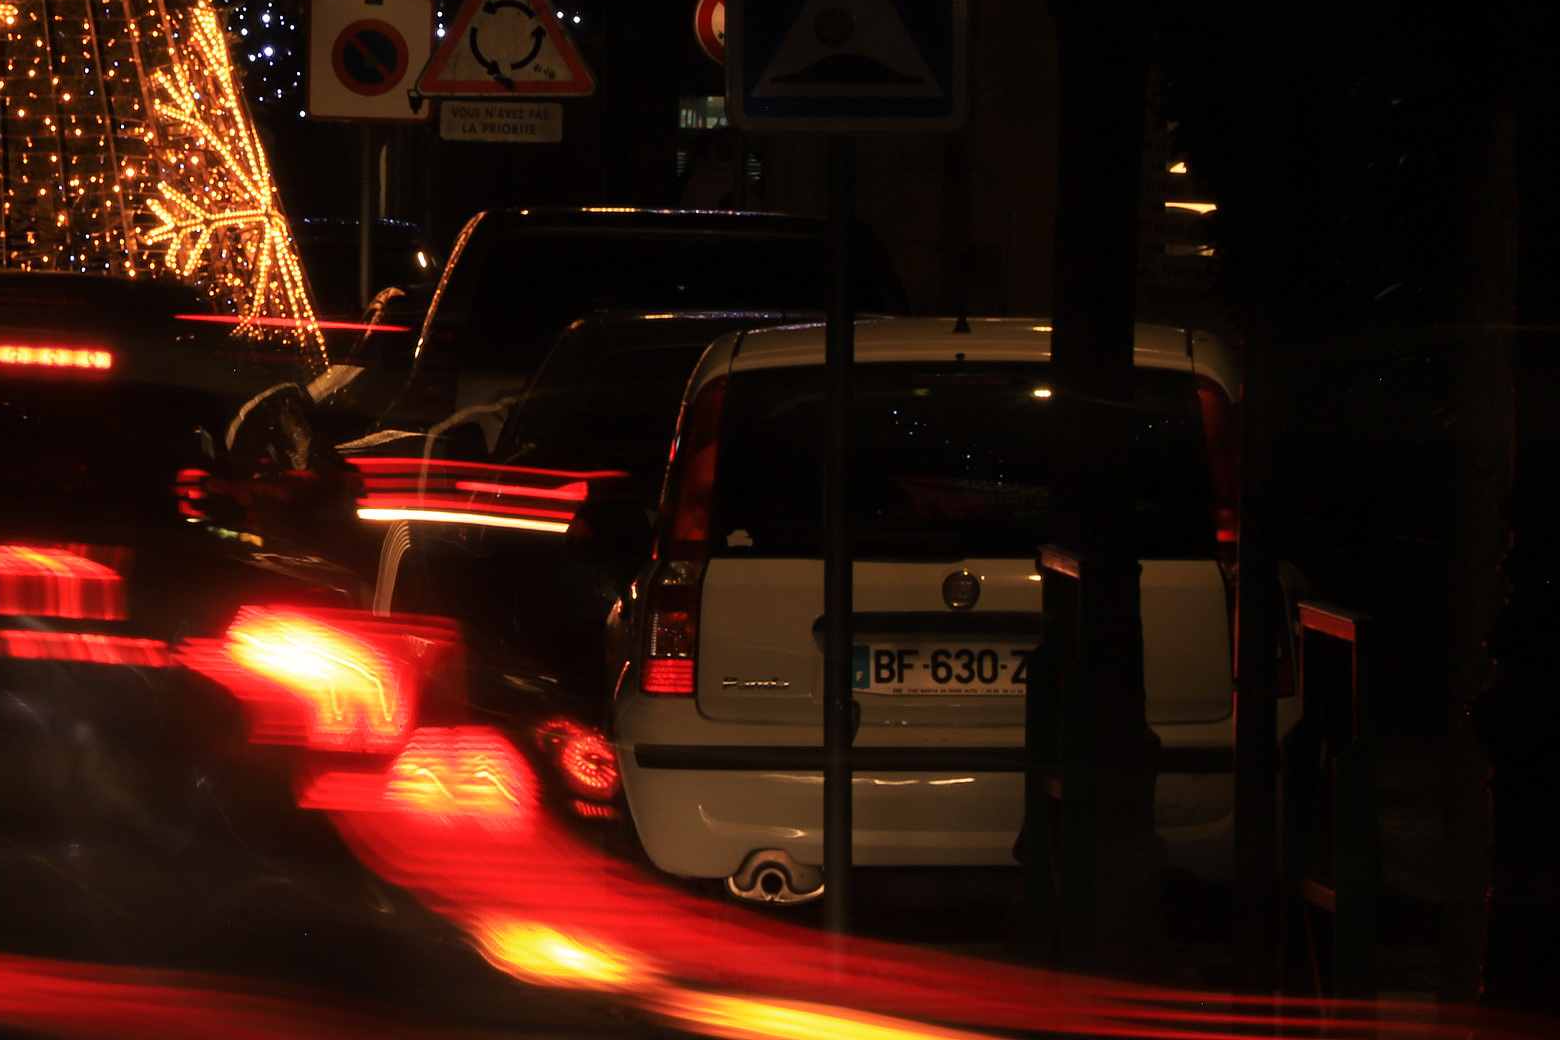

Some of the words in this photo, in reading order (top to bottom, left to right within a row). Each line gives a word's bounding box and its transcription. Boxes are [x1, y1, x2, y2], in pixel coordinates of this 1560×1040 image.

[451, 107, 481, 119] VOUS
[485, 108, 525, 120] N'AVEZ
[528, 109, 550, 121] PAS
[462, 123, 476, 134] LA
[874, 648, 1035, 684] BF-630-Z
